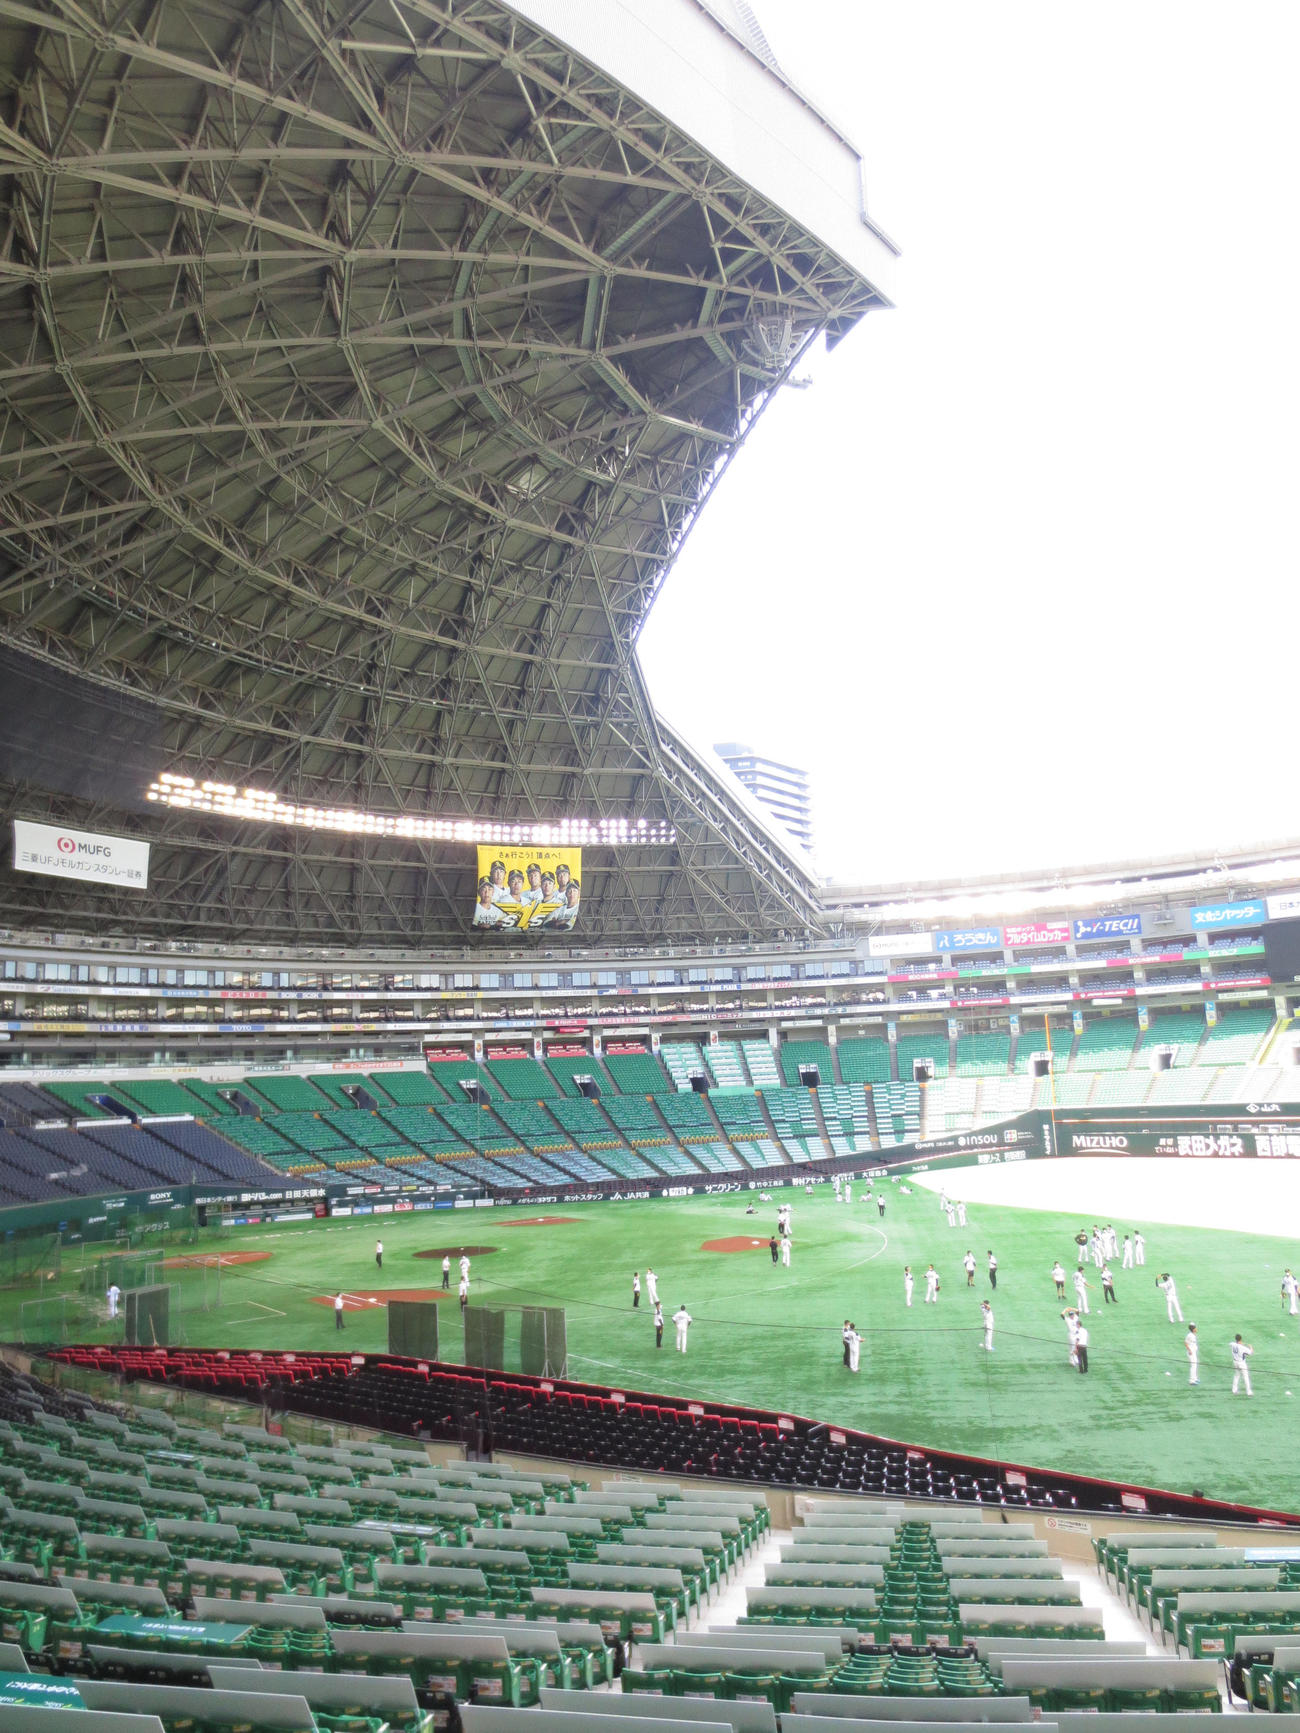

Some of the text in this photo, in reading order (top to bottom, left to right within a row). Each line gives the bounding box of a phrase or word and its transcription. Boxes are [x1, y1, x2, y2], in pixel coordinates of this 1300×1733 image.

[78, 843, 112, 857] MUFG
[1194, 906, 1261, 923] 文化シャッター
[953, 932, 997, 946] ろうきん
[1006, 932, 1068, 945] フルタイムロッカー
[1072, 1135, 1128, 1148] MIZUHO
[705, 1182, 741, 1193] サニクリーン
[150, 1192, 171, 1200] SONY
[564, 1194, 603, 1202] ホットスタッフ
